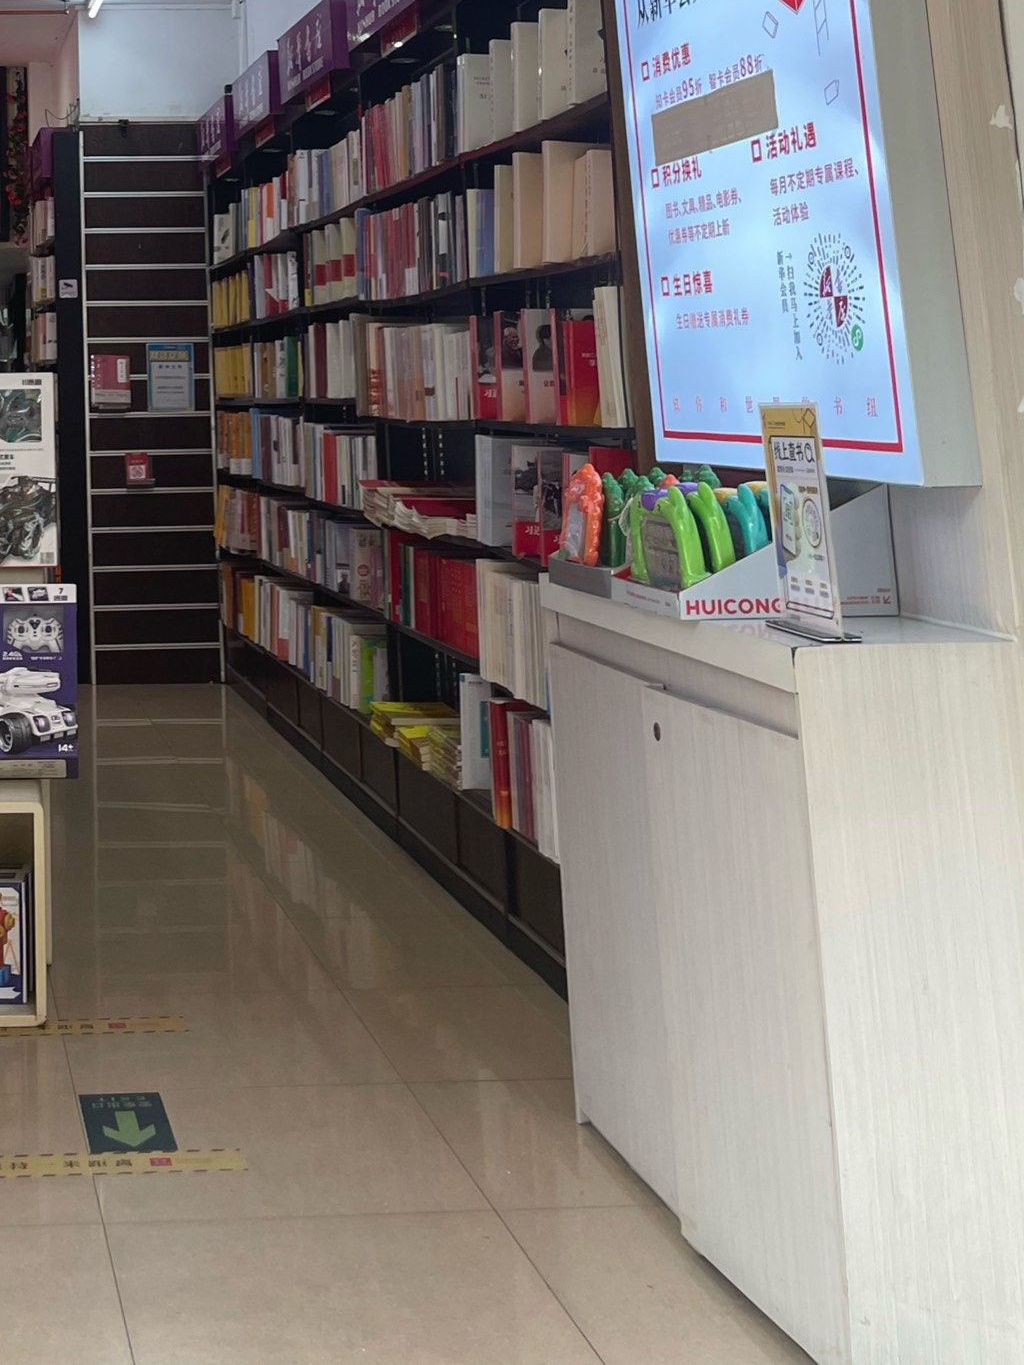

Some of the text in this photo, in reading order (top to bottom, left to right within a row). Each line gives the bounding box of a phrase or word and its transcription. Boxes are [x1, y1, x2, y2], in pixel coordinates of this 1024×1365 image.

[652, 42, 692, 78] 消费优惠
[765, 122, 817, 160] 活动礼遇
[662, 156, 702, 186] 积分换礼
[772, 202, 810, 227] 活动体验
[673, 270, 713, 297] 生日惊喜
